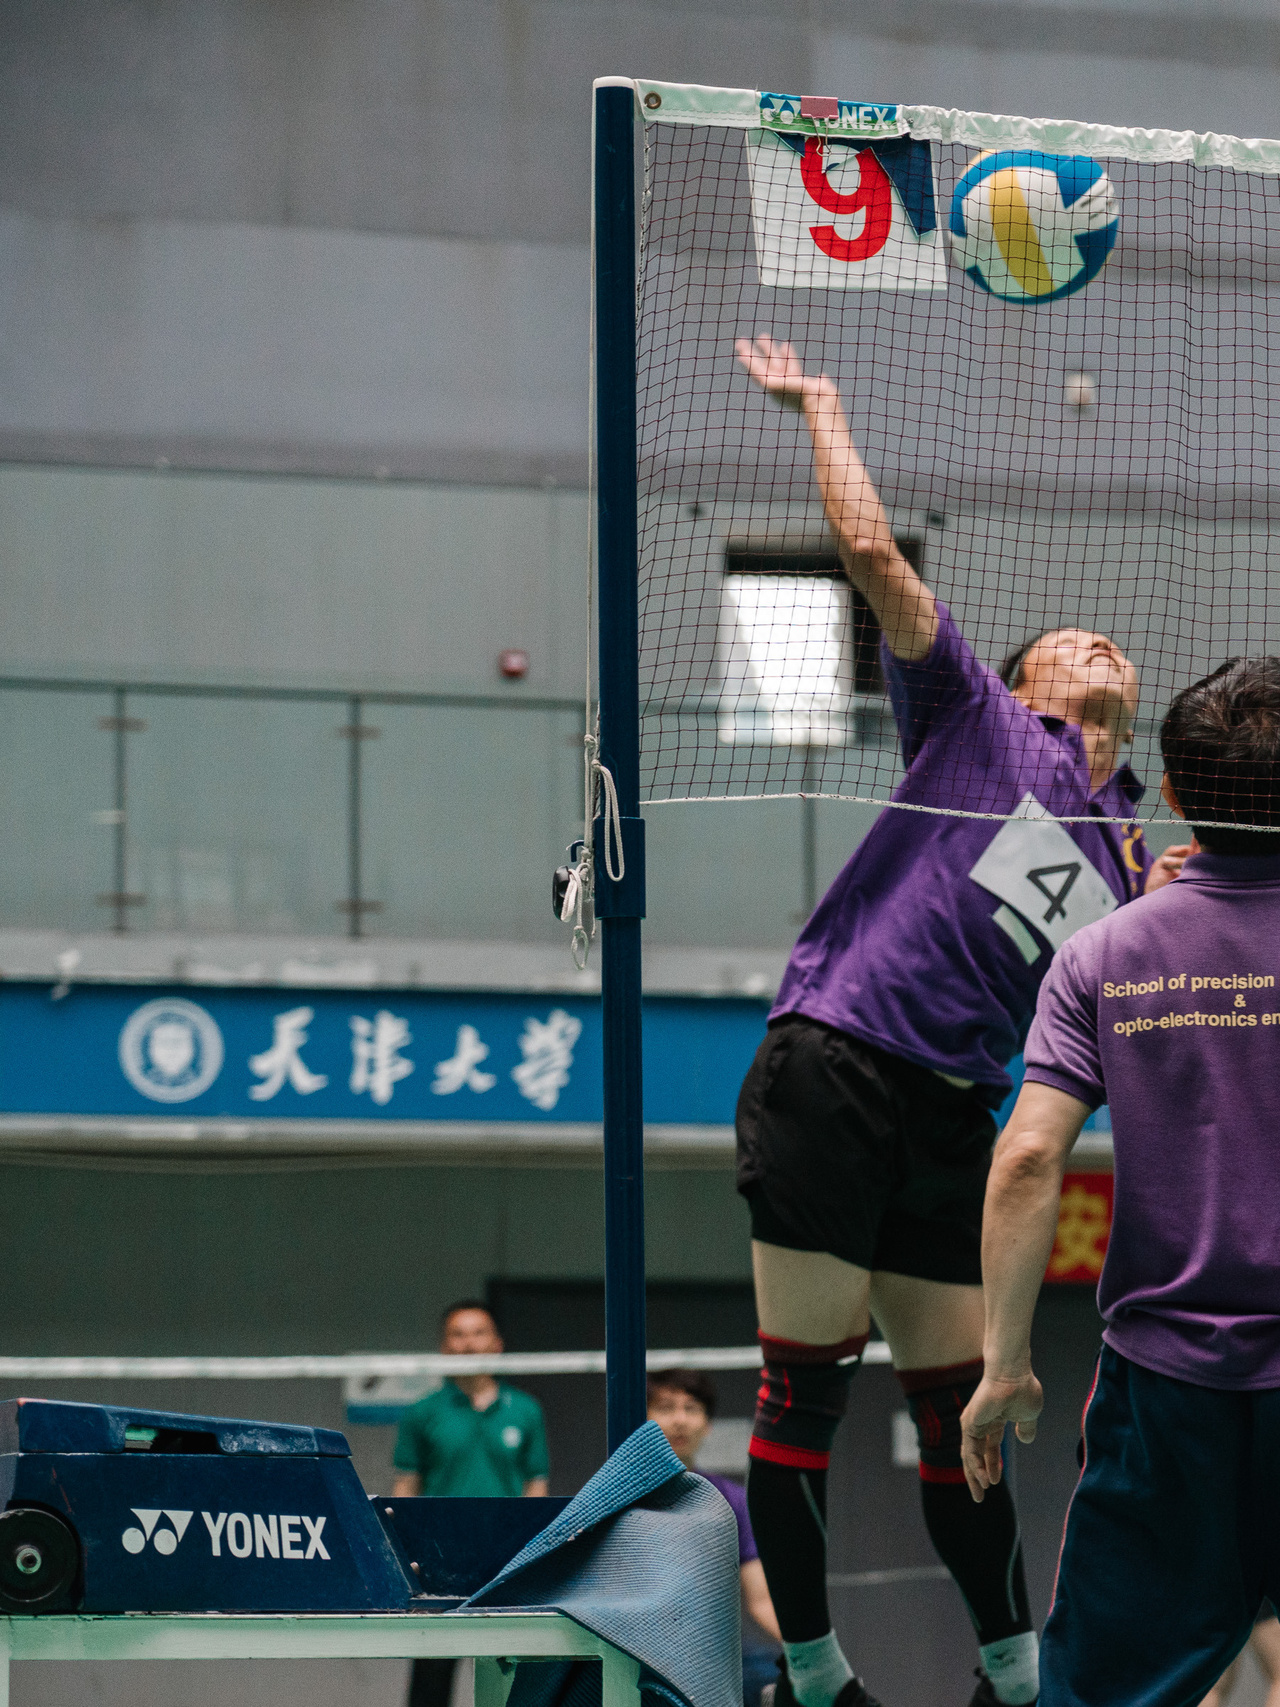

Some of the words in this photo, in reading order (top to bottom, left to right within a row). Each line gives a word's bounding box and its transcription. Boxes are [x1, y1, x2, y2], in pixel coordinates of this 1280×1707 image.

[812, 104, 889, 130] ONEX
[800, 137, 892, 261] 9
[1027, 861, 1082, 924] 4
[1103, 976, 1164, 998] School
[1168, 974, 1187, 990] of
[1190, 973, 1275, 992] precision
[1234, 993, 1247, 1008] &
[1113, 1011, 1258, 1037] opto-electronics
[249, 1005, 582, 1111] 天津大学
[201, 1511, 331, 1560] YONEX
